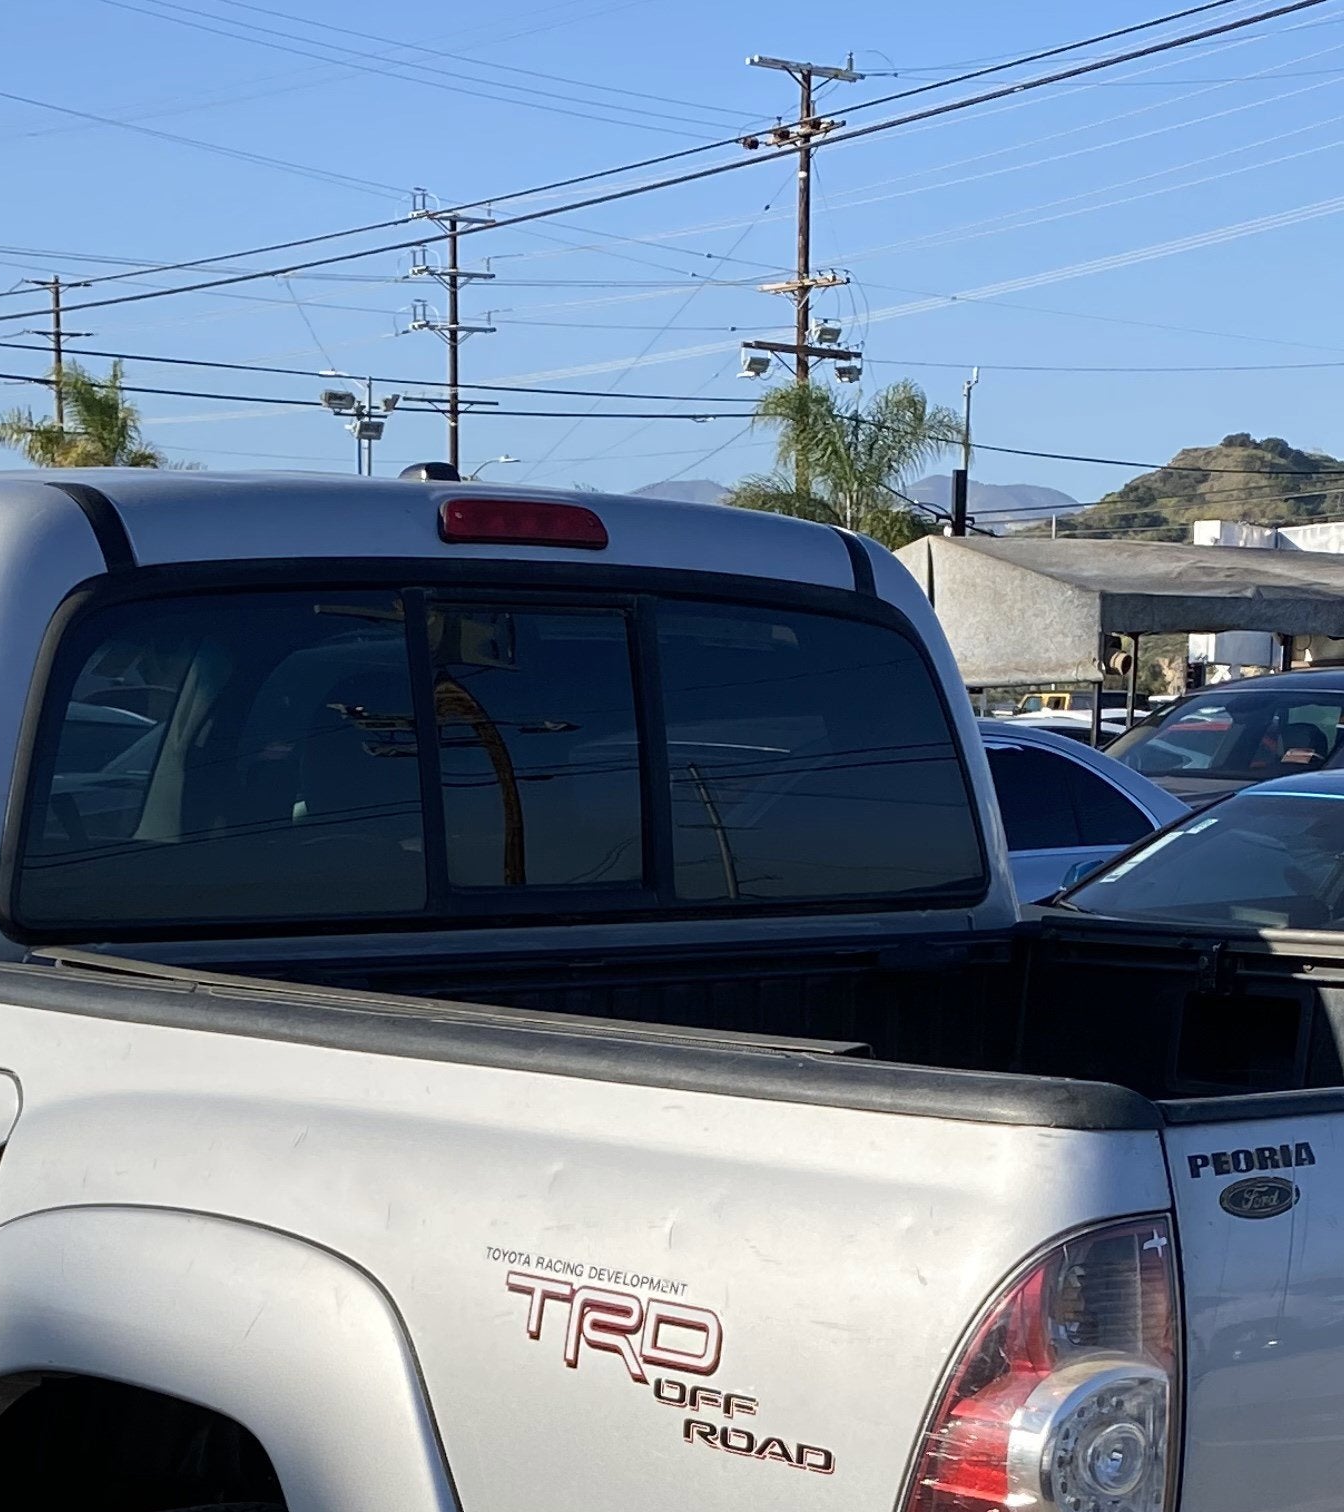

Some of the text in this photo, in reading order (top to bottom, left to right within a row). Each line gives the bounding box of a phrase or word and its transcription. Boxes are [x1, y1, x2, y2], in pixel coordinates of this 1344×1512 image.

[1186, 1141, 1316, 1179] PEORIA
[486, 1246, 688, 1297] TOYOTA RACING DEVELOPMENT
[506, 1270, 723, 1385] TRD
[653, 1378, 759, 1418] OFF
[683, 1418, 836, 1475] ROAD
